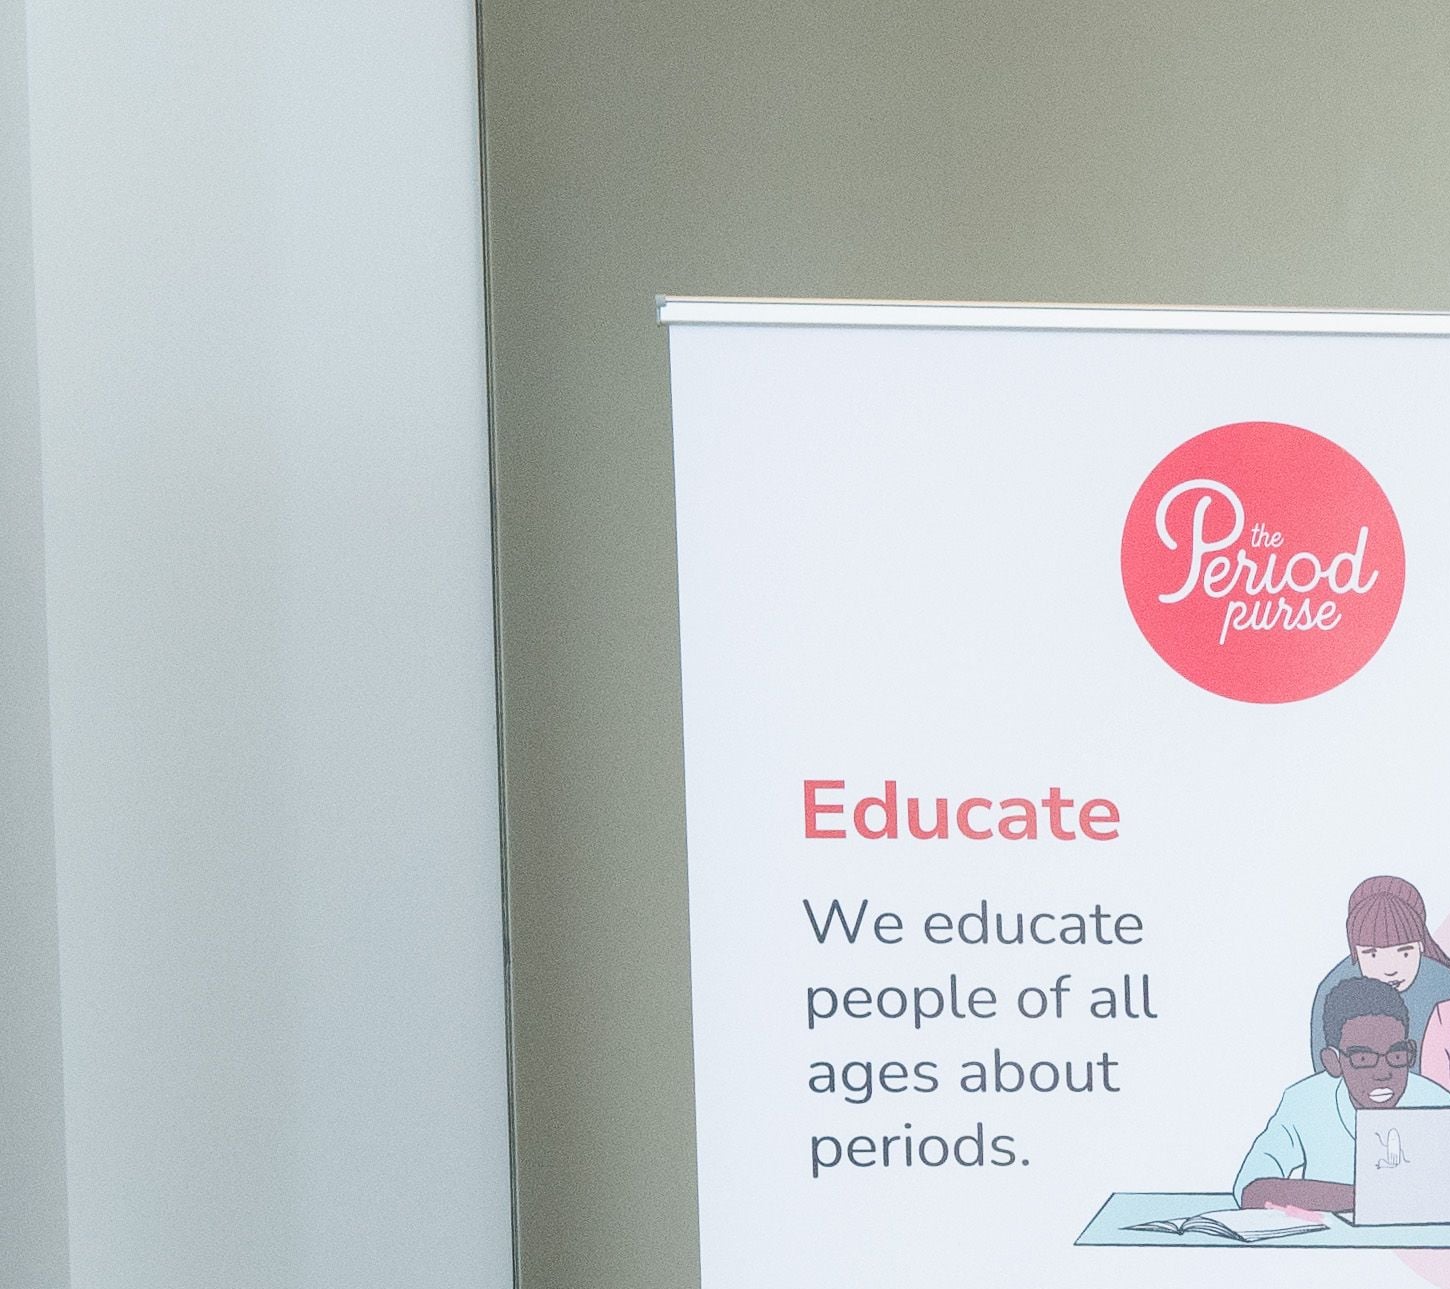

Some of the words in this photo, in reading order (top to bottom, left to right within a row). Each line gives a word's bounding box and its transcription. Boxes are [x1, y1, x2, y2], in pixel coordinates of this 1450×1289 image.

[1155, 478, 1379, 604] Period
[1251, 523, 1284, 548] the
[1219, 597, 1342, 645] purse
[804, 780, 1120, 841] Educate
[803, 899, 903, 944] We
[924, 900, 1143, 945] educate
[807, 974, 996, 1029] people
[1018, 974, 1071, 1018] of
[1090, 974, 1157, 1018] all
[809, 1062, 938, 1104] ages
[961, 1048, 1120, 1092] about
[812, 1122, 1029, 1178] periods.
